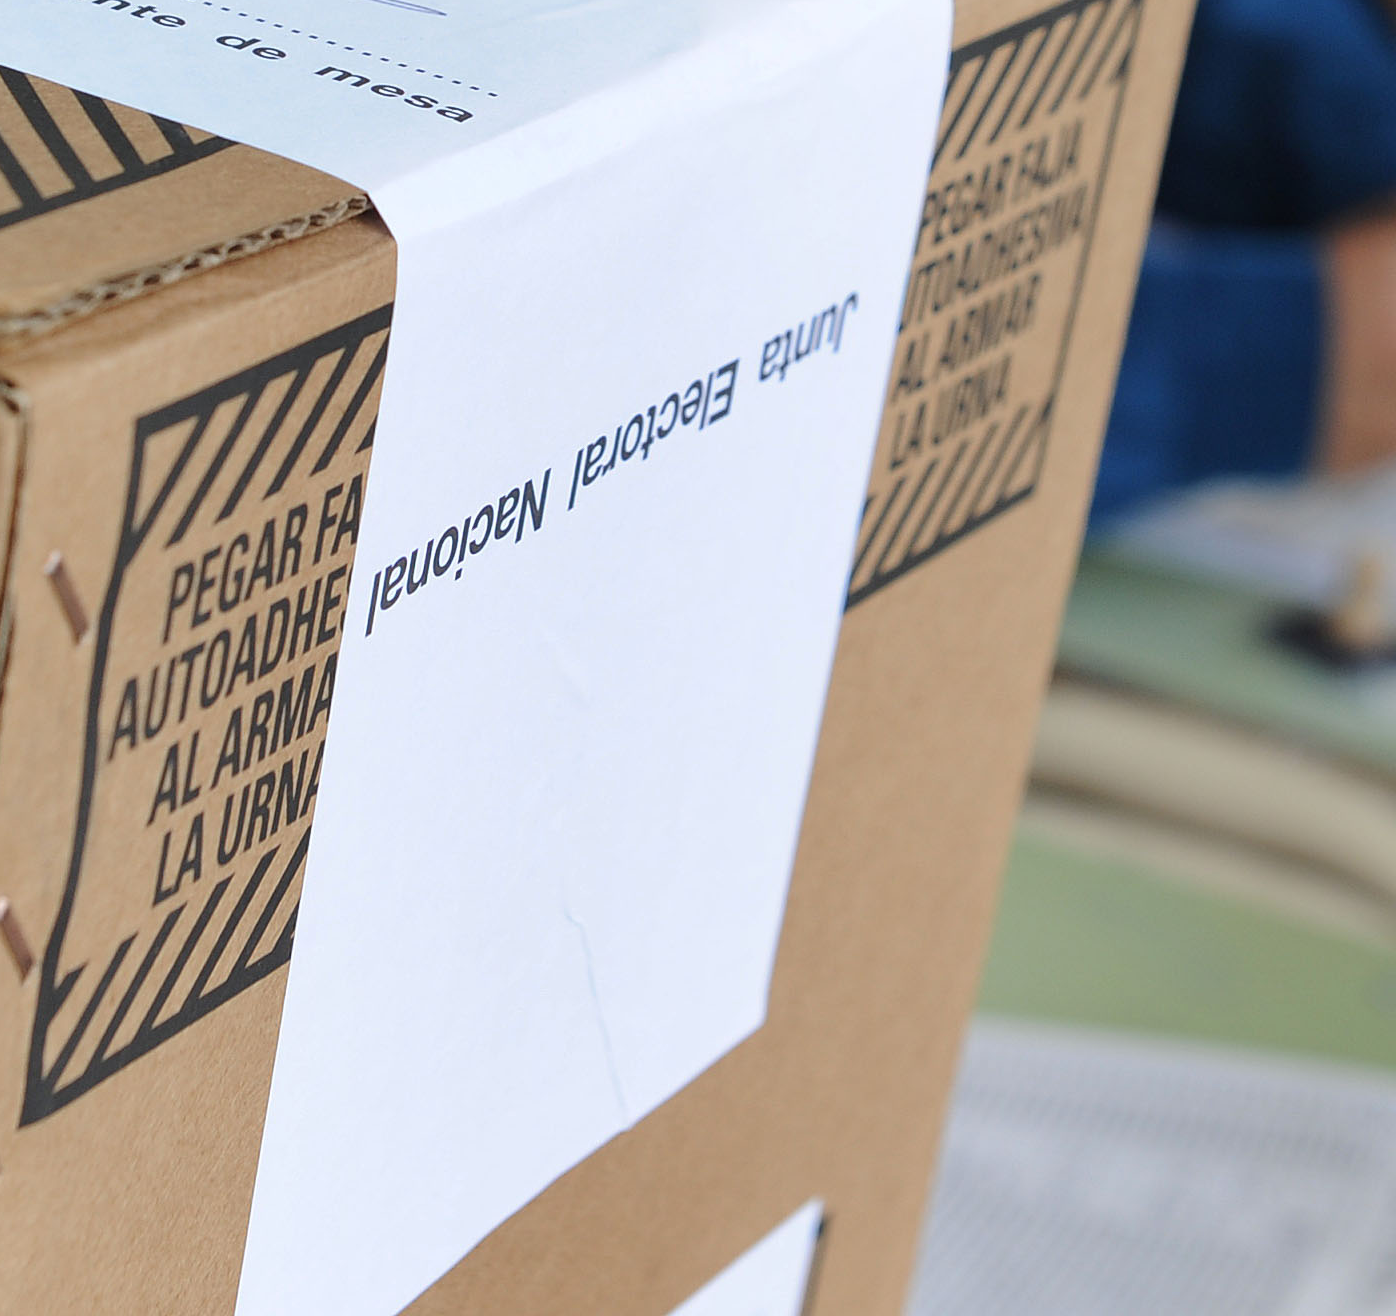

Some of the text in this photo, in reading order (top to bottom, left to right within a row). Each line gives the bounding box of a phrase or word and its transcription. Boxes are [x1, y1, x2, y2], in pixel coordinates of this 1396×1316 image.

[215, 34, 288, 61] de
[313, 65, 475, 124] mesa
[914, 118, 1084, 257] PEGAR FAJA
[890, 270, 1041, 403] AL ARMAR
[364, 290, 859, 639] Junta Electoral Nacional
[889, 353, 1014, 469] LA URNA
[162, 502, 309, 645] PEGAR
[106, 556, 354, 763] AUTOADHE
[146, 729, 202, 827] AL
[152, 810, 205, 910] LA
